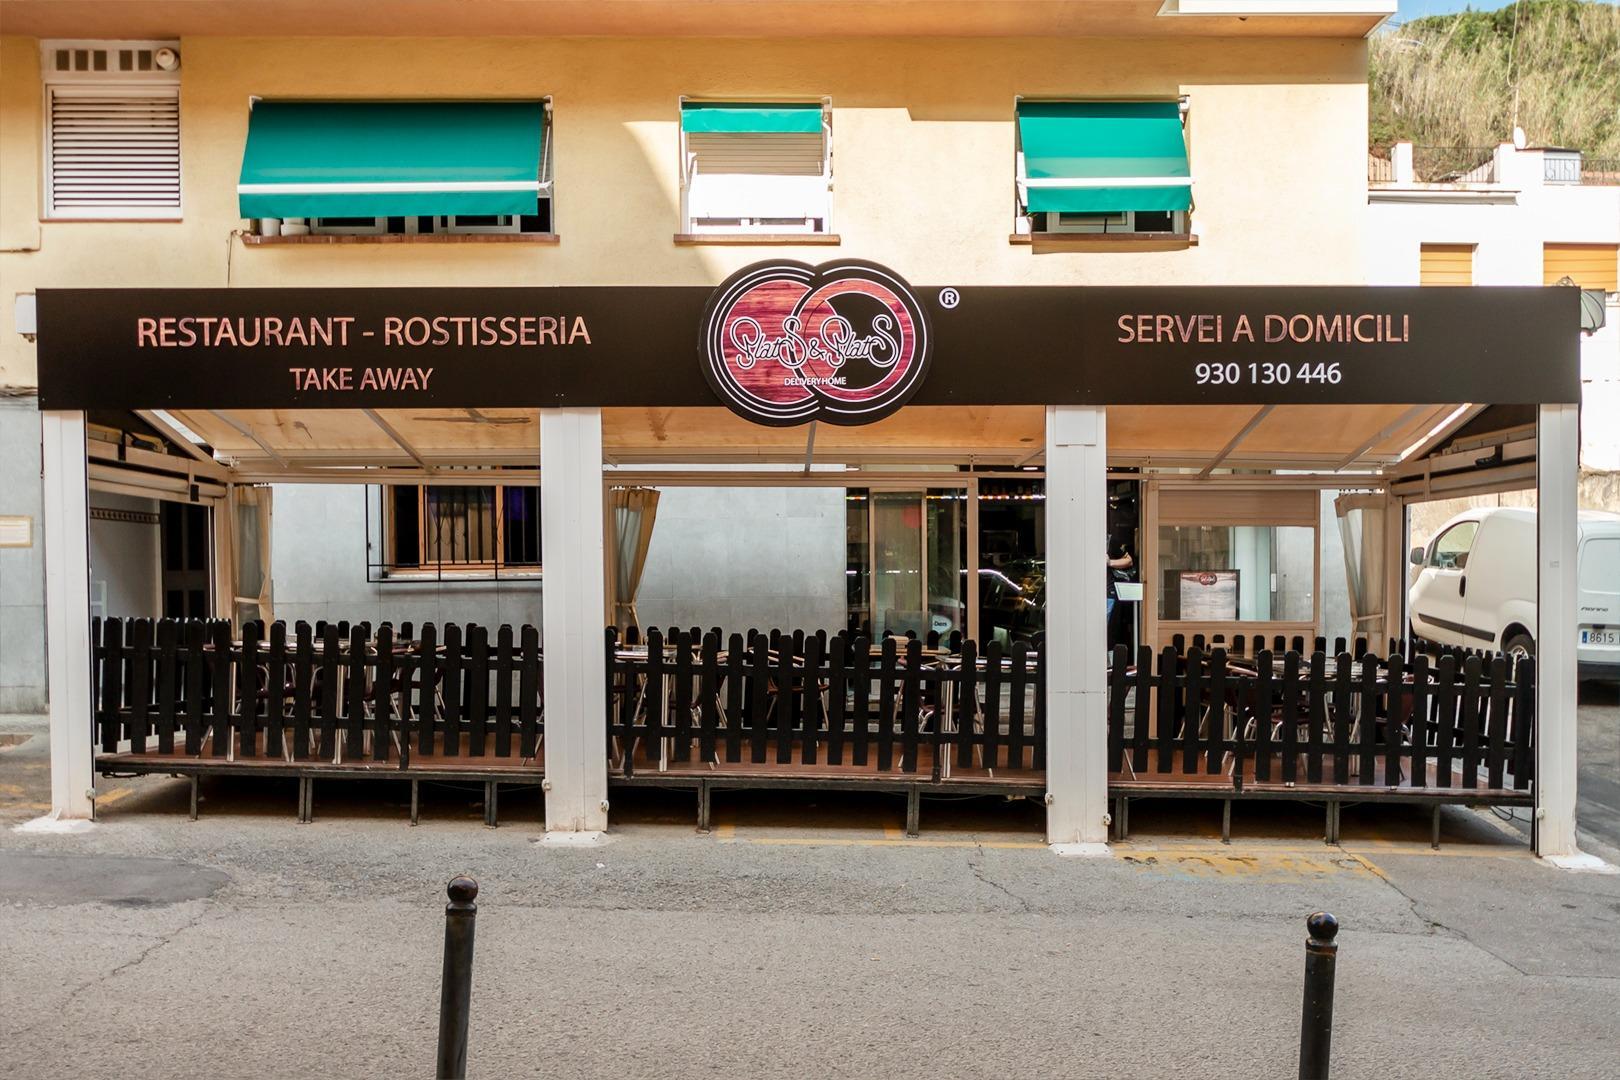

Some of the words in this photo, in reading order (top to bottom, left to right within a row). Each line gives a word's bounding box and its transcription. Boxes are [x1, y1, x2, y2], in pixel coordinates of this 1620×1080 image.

[137, 317, 355, 347] RESTAURANT
[384, 316, 592, 346] ROSTISSERIA
[1117, 314, 1223, 343] SERVEI
[1231, 314, 1255, 342] A
[1264, 314, 1410, 343] DOMICILI
[809, 337, 827, 361] &
[289, 367, 354, 391] TAKE
[359, 367, 434, 391] AWAY
[1195, 362, 1240, 385] 930
[1248, 362, 1291, 385] 130
[1296, 362, 1342, 385] 446
[1589, 632, 1615, 643] 8615
